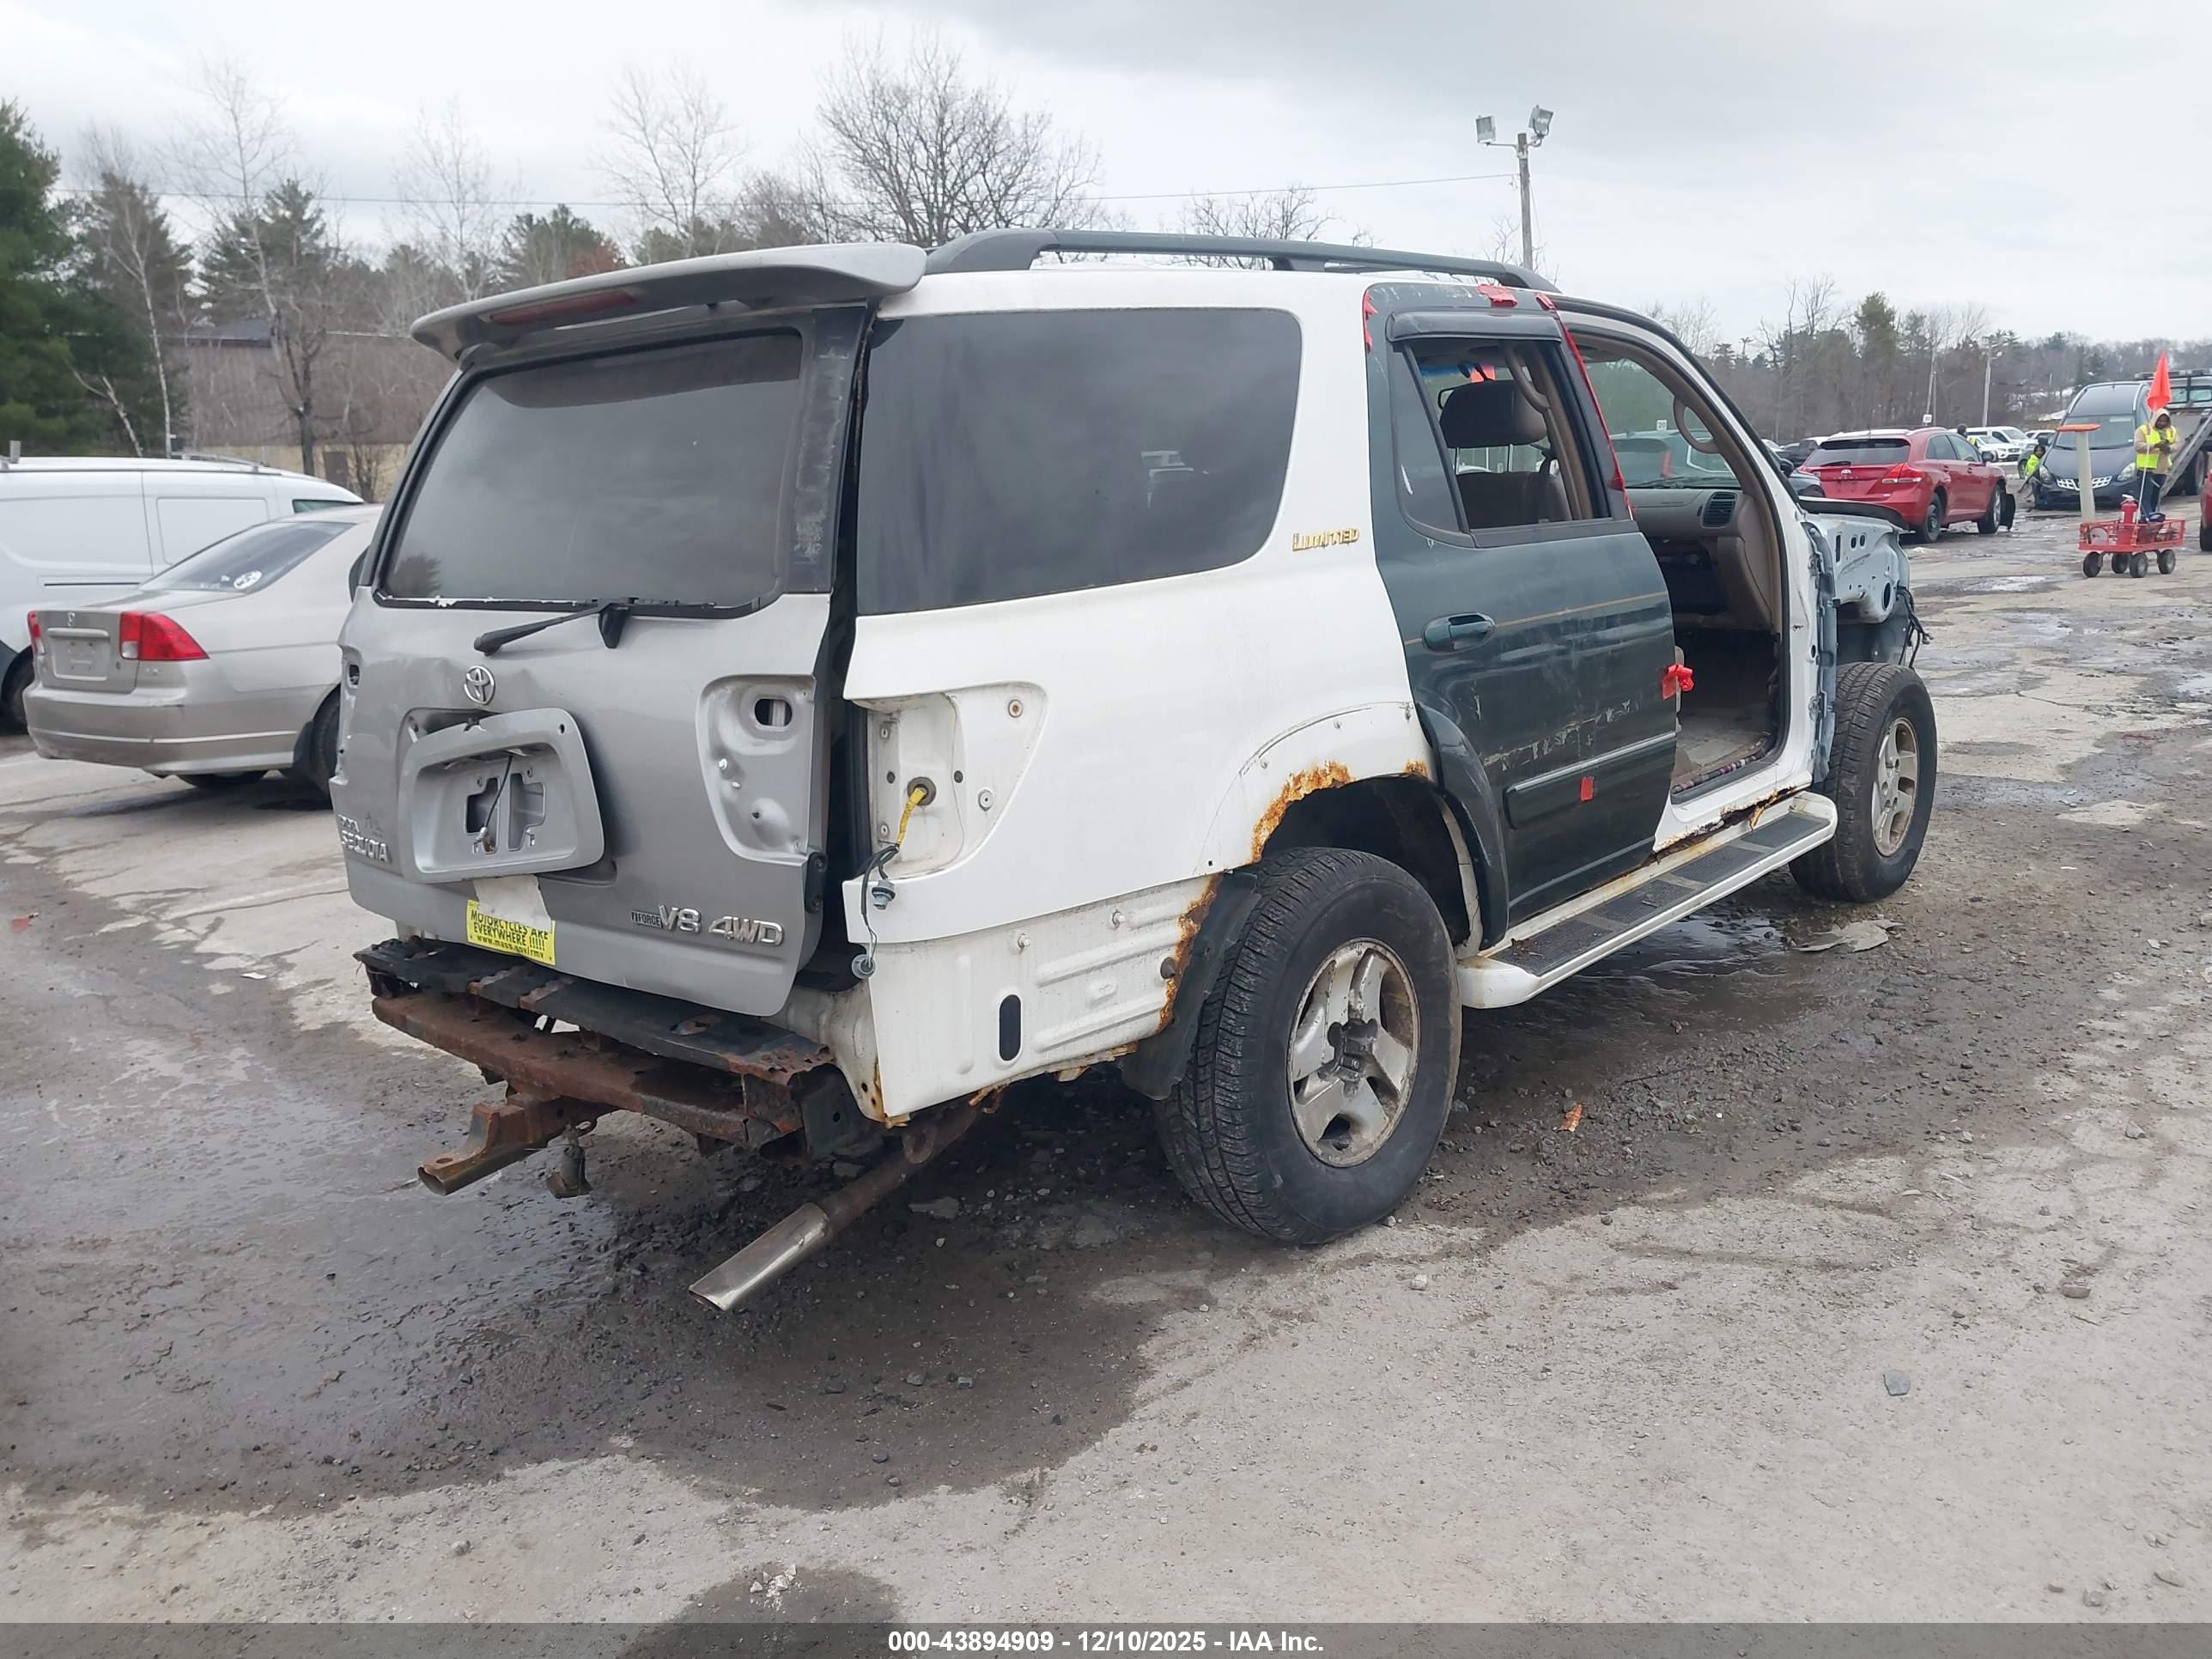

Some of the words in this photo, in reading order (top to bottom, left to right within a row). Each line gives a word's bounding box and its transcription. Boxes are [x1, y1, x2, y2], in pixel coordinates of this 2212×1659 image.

[1292, 529, 1358, 551] LIMITED
[471, 910, 528, 935] MOTORCYCLES
[531, 930, 549, 940] ARE
[473, 922, 526, 946] EVERYWHERE
[659, 904, 701, 934] V8
[708, 915, 784, 945] 4WD
